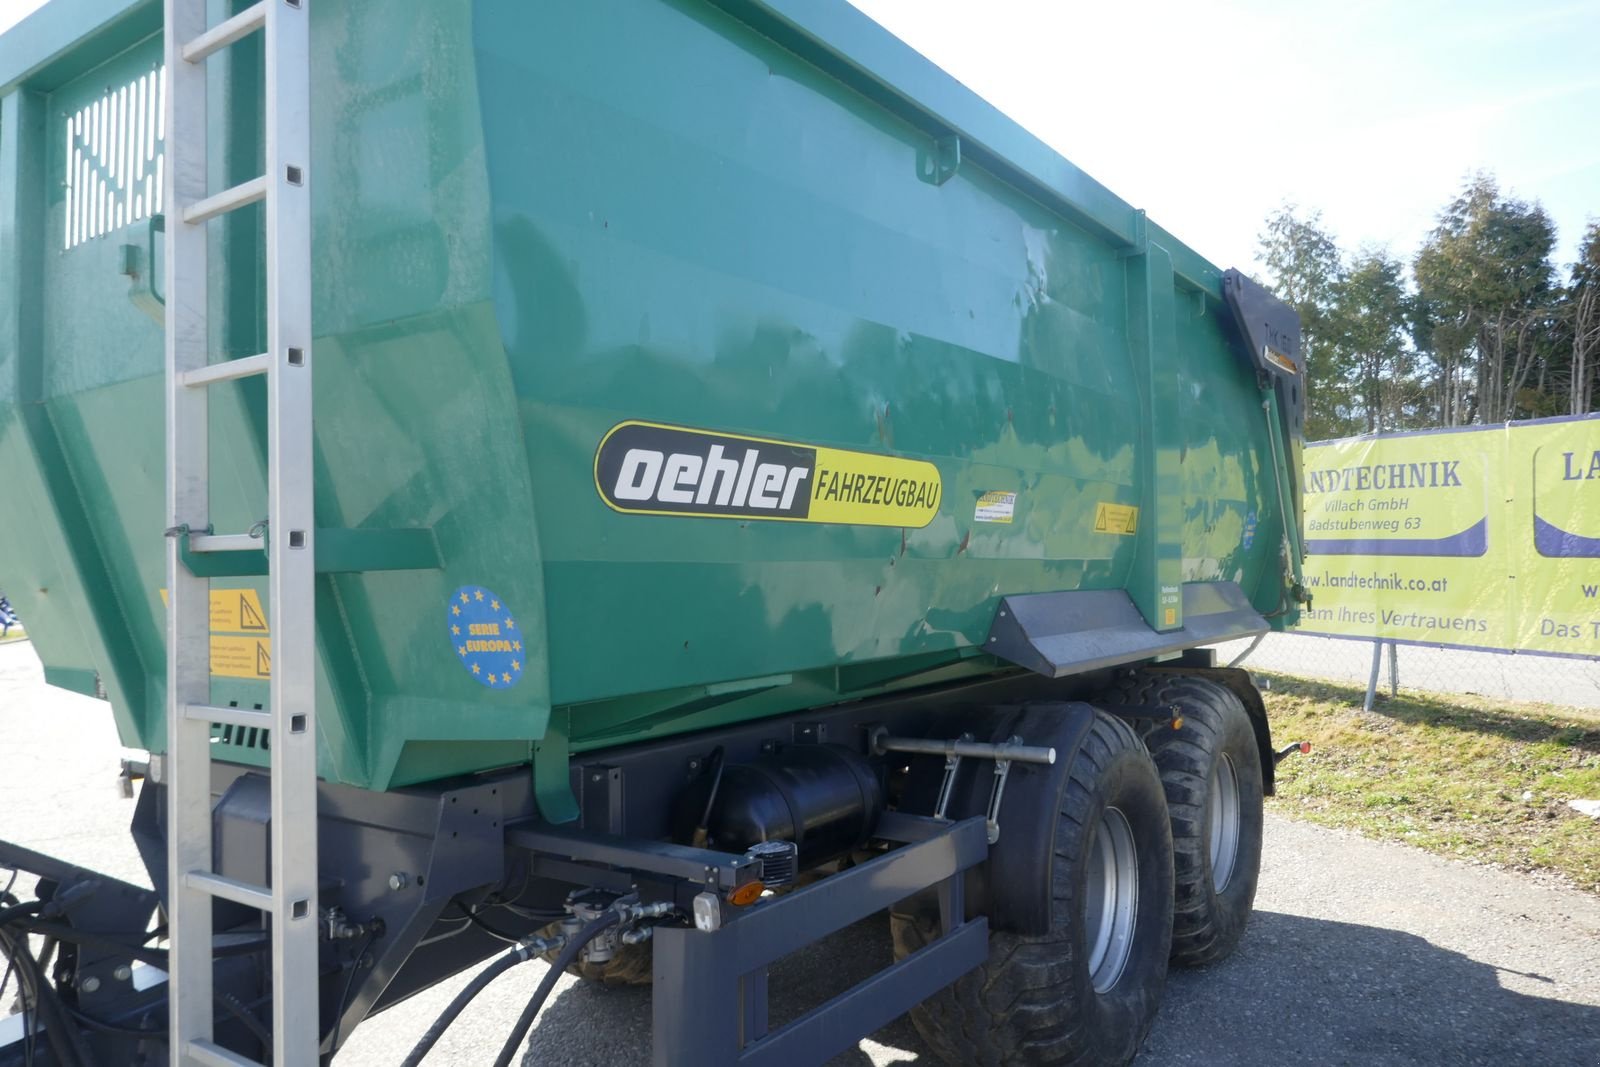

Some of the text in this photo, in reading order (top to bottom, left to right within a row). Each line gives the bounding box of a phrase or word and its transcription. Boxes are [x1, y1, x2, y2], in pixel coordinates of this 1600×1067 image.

[1562, 449, 1600, 480] LA
[613, 444, 939, 510] oehler FAHRZEUGBAU
[1324, 497, 1409, 513] Villach GmbH
[1308, 517, 1421, 533] Badstubenweg 63
[1337, 607, 1375, 624] Ihres
[1381, 610, 1487, 632] Vertrauens
[1541, 618, 1580, 638] Das
[466, 639, 512, 652] EUROPA
